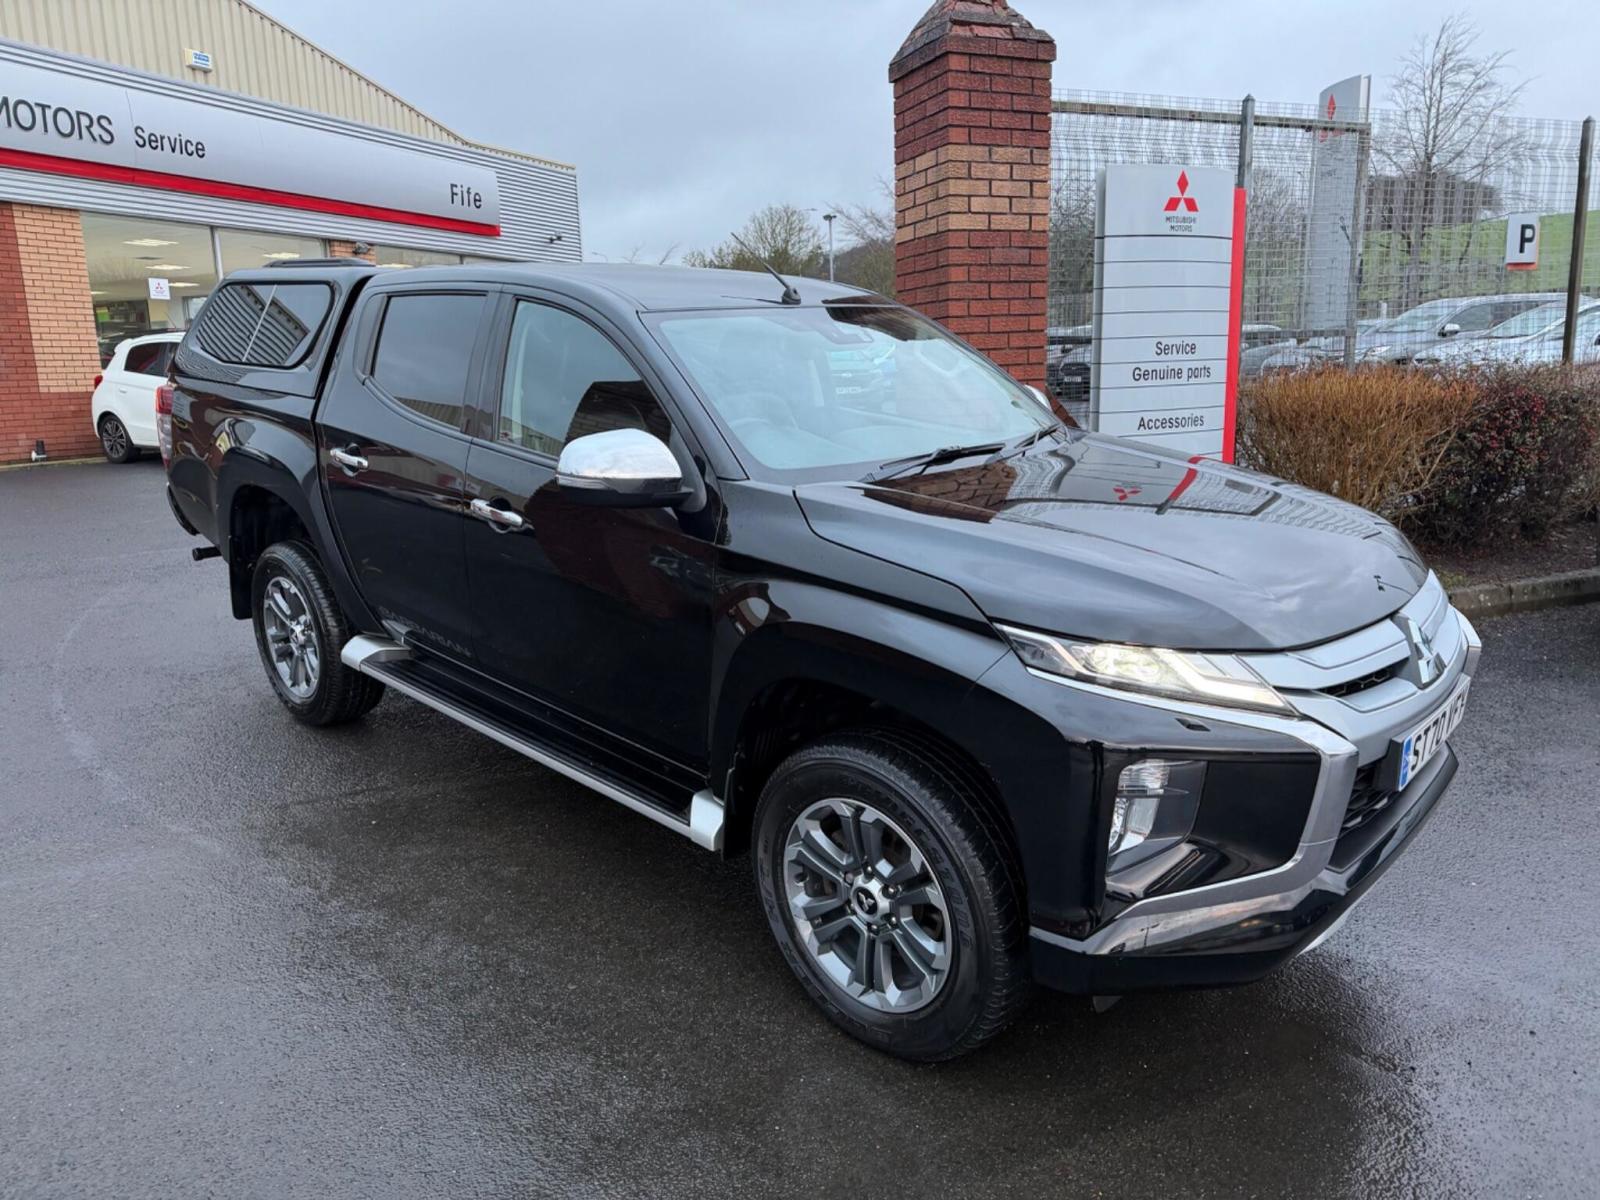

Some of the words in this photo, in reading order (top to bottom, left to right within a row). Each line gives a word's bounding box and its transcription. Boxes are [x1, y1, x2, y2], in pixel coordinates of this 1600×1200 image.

[134, 125, 206, 158] Service
[450, 183, 482, 209] Fife
[1165, 215, 1197, 224] MITSUBISHI
[1170, 224, 1193, 232] MOTORS
[1519, 223, 1536, 254] P
[1155, 341, 1197, 356] Service
[1132, 366, 1183, 382] Genuine
[1187, 365, 1212, 382] parts
[1137, 413, 1205, 431] Accessories
[1410, 709, 1447, 772] ST70
